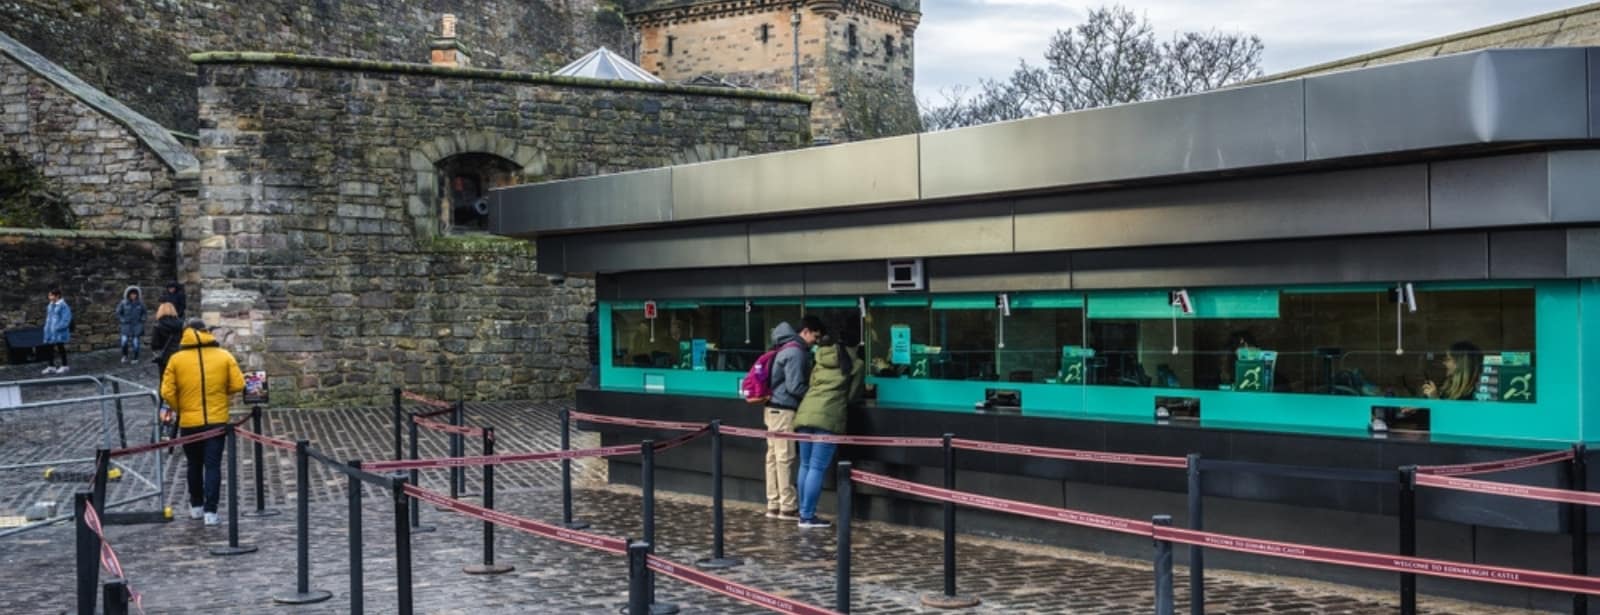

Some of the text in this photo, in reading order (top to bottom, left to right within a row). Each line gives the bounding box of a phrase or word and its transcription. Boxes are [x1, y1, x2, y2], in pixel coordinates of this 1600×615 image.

[1393, 559, 1519, 581] WELCOME TO EDINBURGH CASTLE
